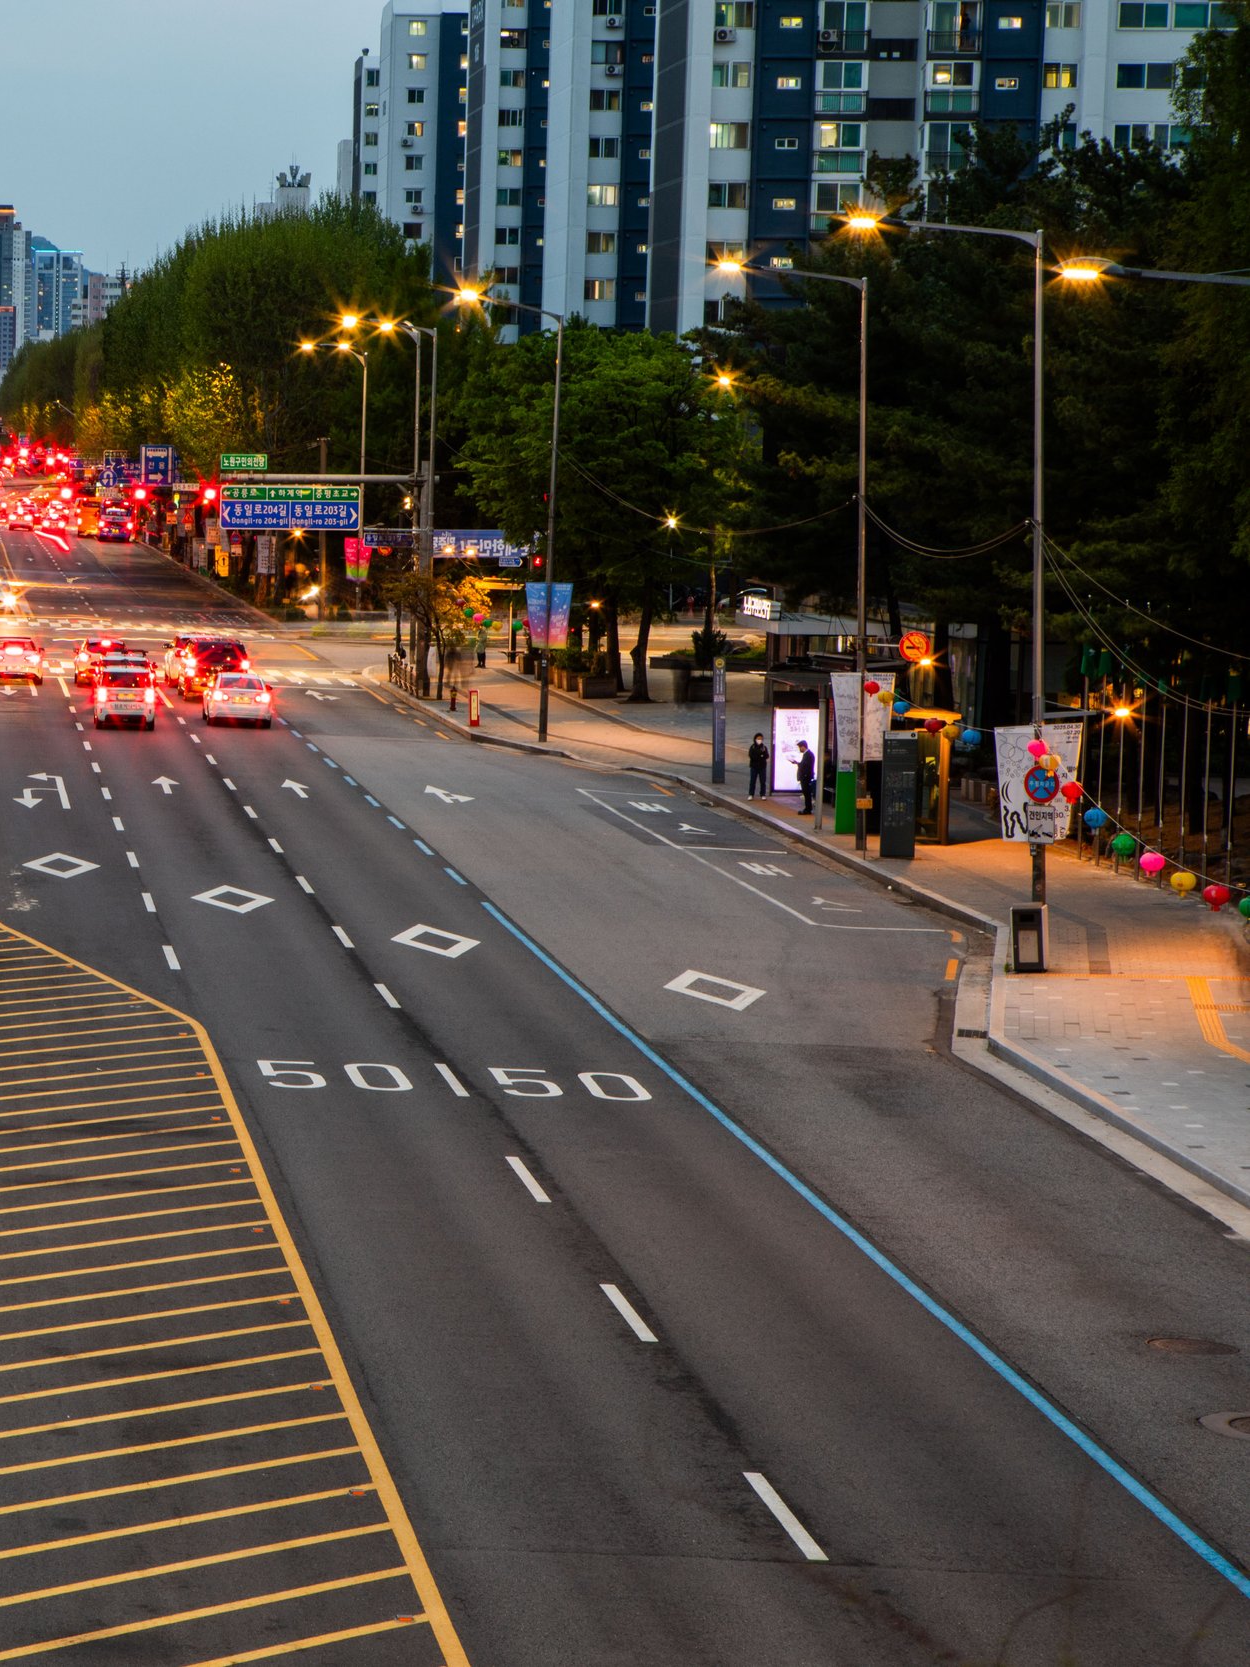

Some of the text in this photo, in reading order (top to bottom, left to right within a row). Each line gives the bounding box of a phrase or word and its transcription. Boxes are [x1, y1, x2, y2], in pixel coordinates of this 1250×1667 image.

[223, 456, 265, 467] 노원구민의전당
[278, 488, 303, 498] 하계역
[233, 504, 287, 517] 동일로204길
[294, 504, 347, 517] 동일로203길
[231, 517, 289, 527] Dongil-ro 204-gil
[291, 518, 349, 527] Dongil-ro 203-gil
[1028, 811, 1054, 820] 견인지역
